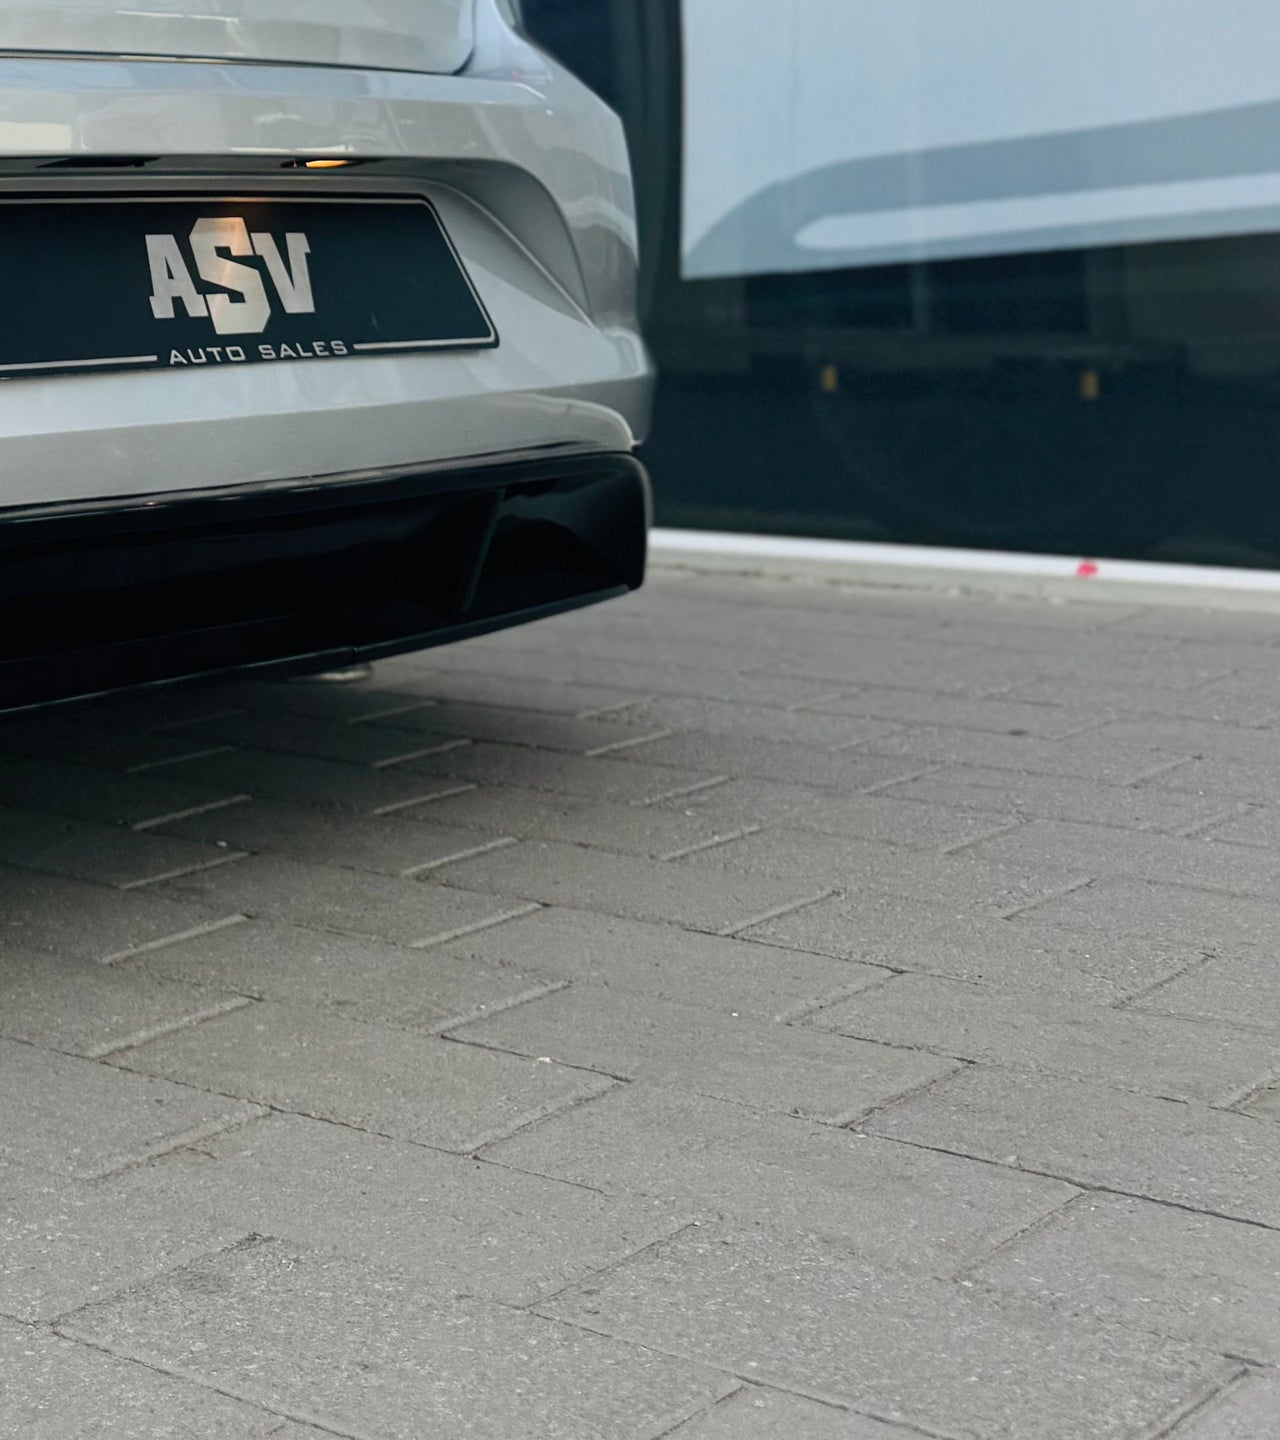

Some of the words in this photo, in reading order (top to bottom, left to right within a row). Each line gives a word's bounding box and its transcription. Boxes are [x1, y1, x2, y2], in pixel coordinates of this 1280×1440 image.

[145, 217, 315, 335] ASV
[169, 345, 246, 365] AUTO
[258, 340, 348, 359] SALES
